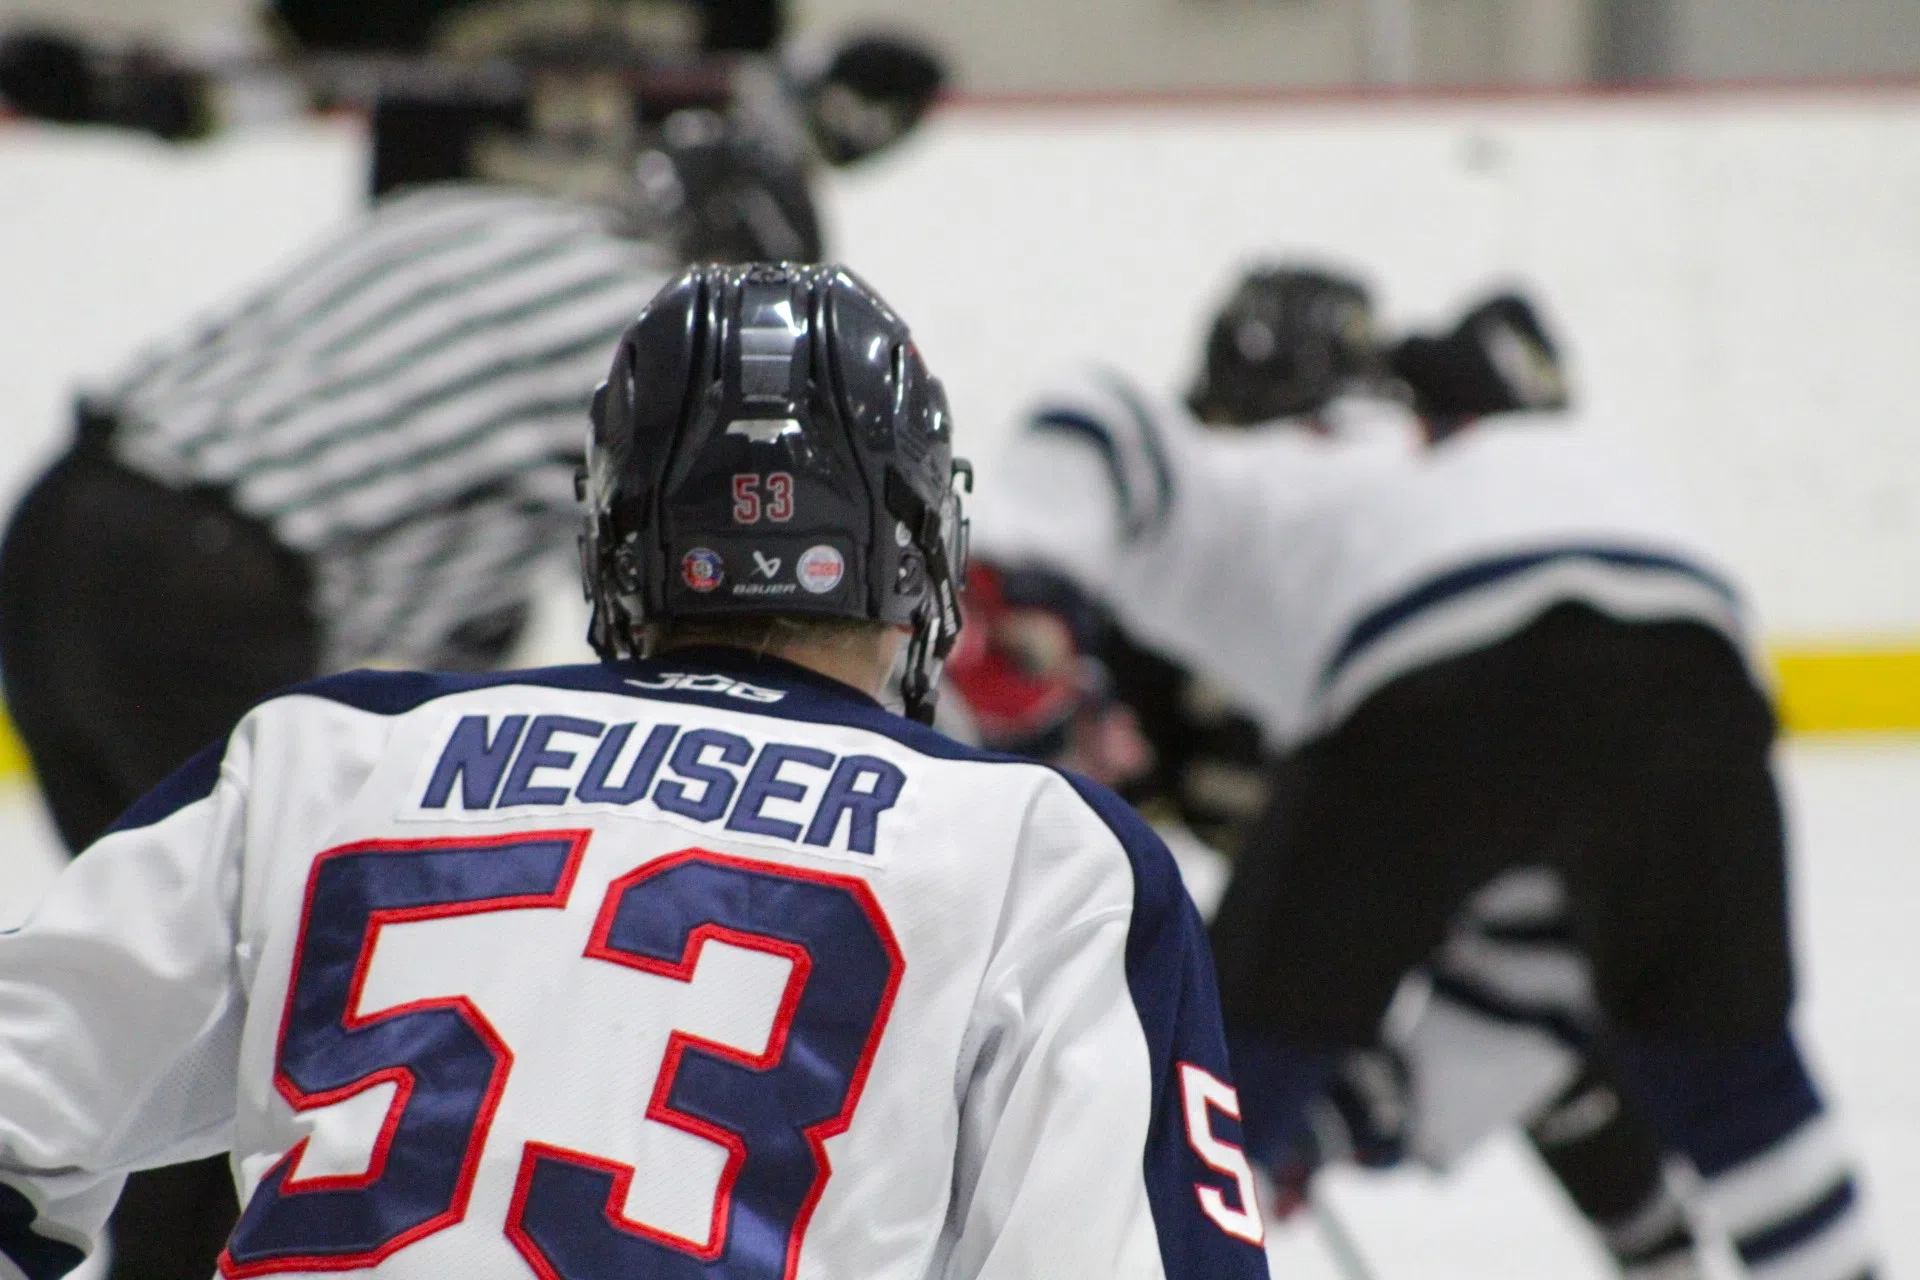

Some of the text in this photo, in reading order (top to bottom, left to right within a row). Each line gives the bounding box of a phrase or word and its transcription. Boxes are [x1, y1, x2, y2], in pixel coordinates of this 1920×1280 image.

[732, 471, 794, 525] 53
[731, 583, 797, 596] BAUER
[420, 714, 907, 856] NEUSER
[218, 829, 906, 1280] 53
[1177, 1061, 1265, 1247] 5
